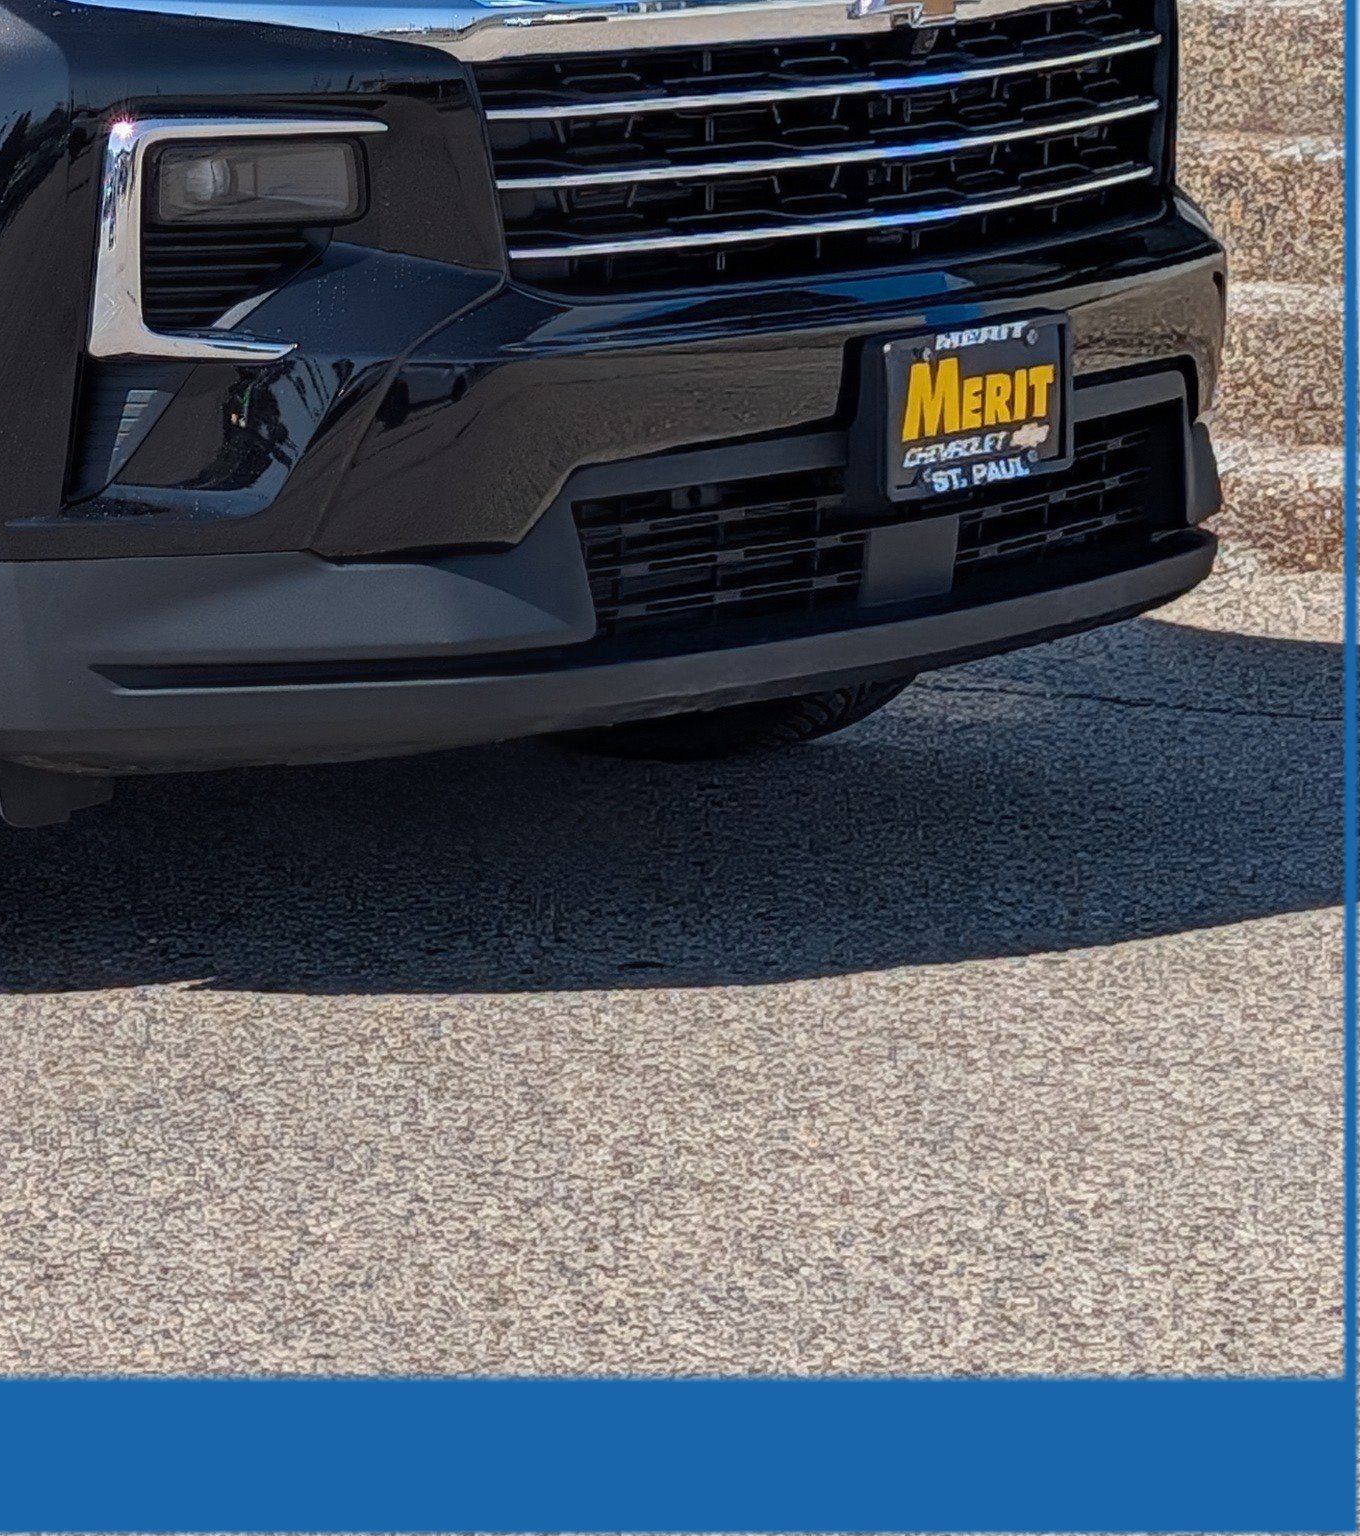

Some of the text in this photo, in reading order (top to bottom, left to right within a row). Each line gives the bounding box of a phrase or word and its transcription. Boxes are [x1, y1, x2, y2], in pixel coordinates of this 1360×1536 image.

[901, 357, 1055, 443] MERIT
[931, 455, 1030, 492] ST. PAUL
